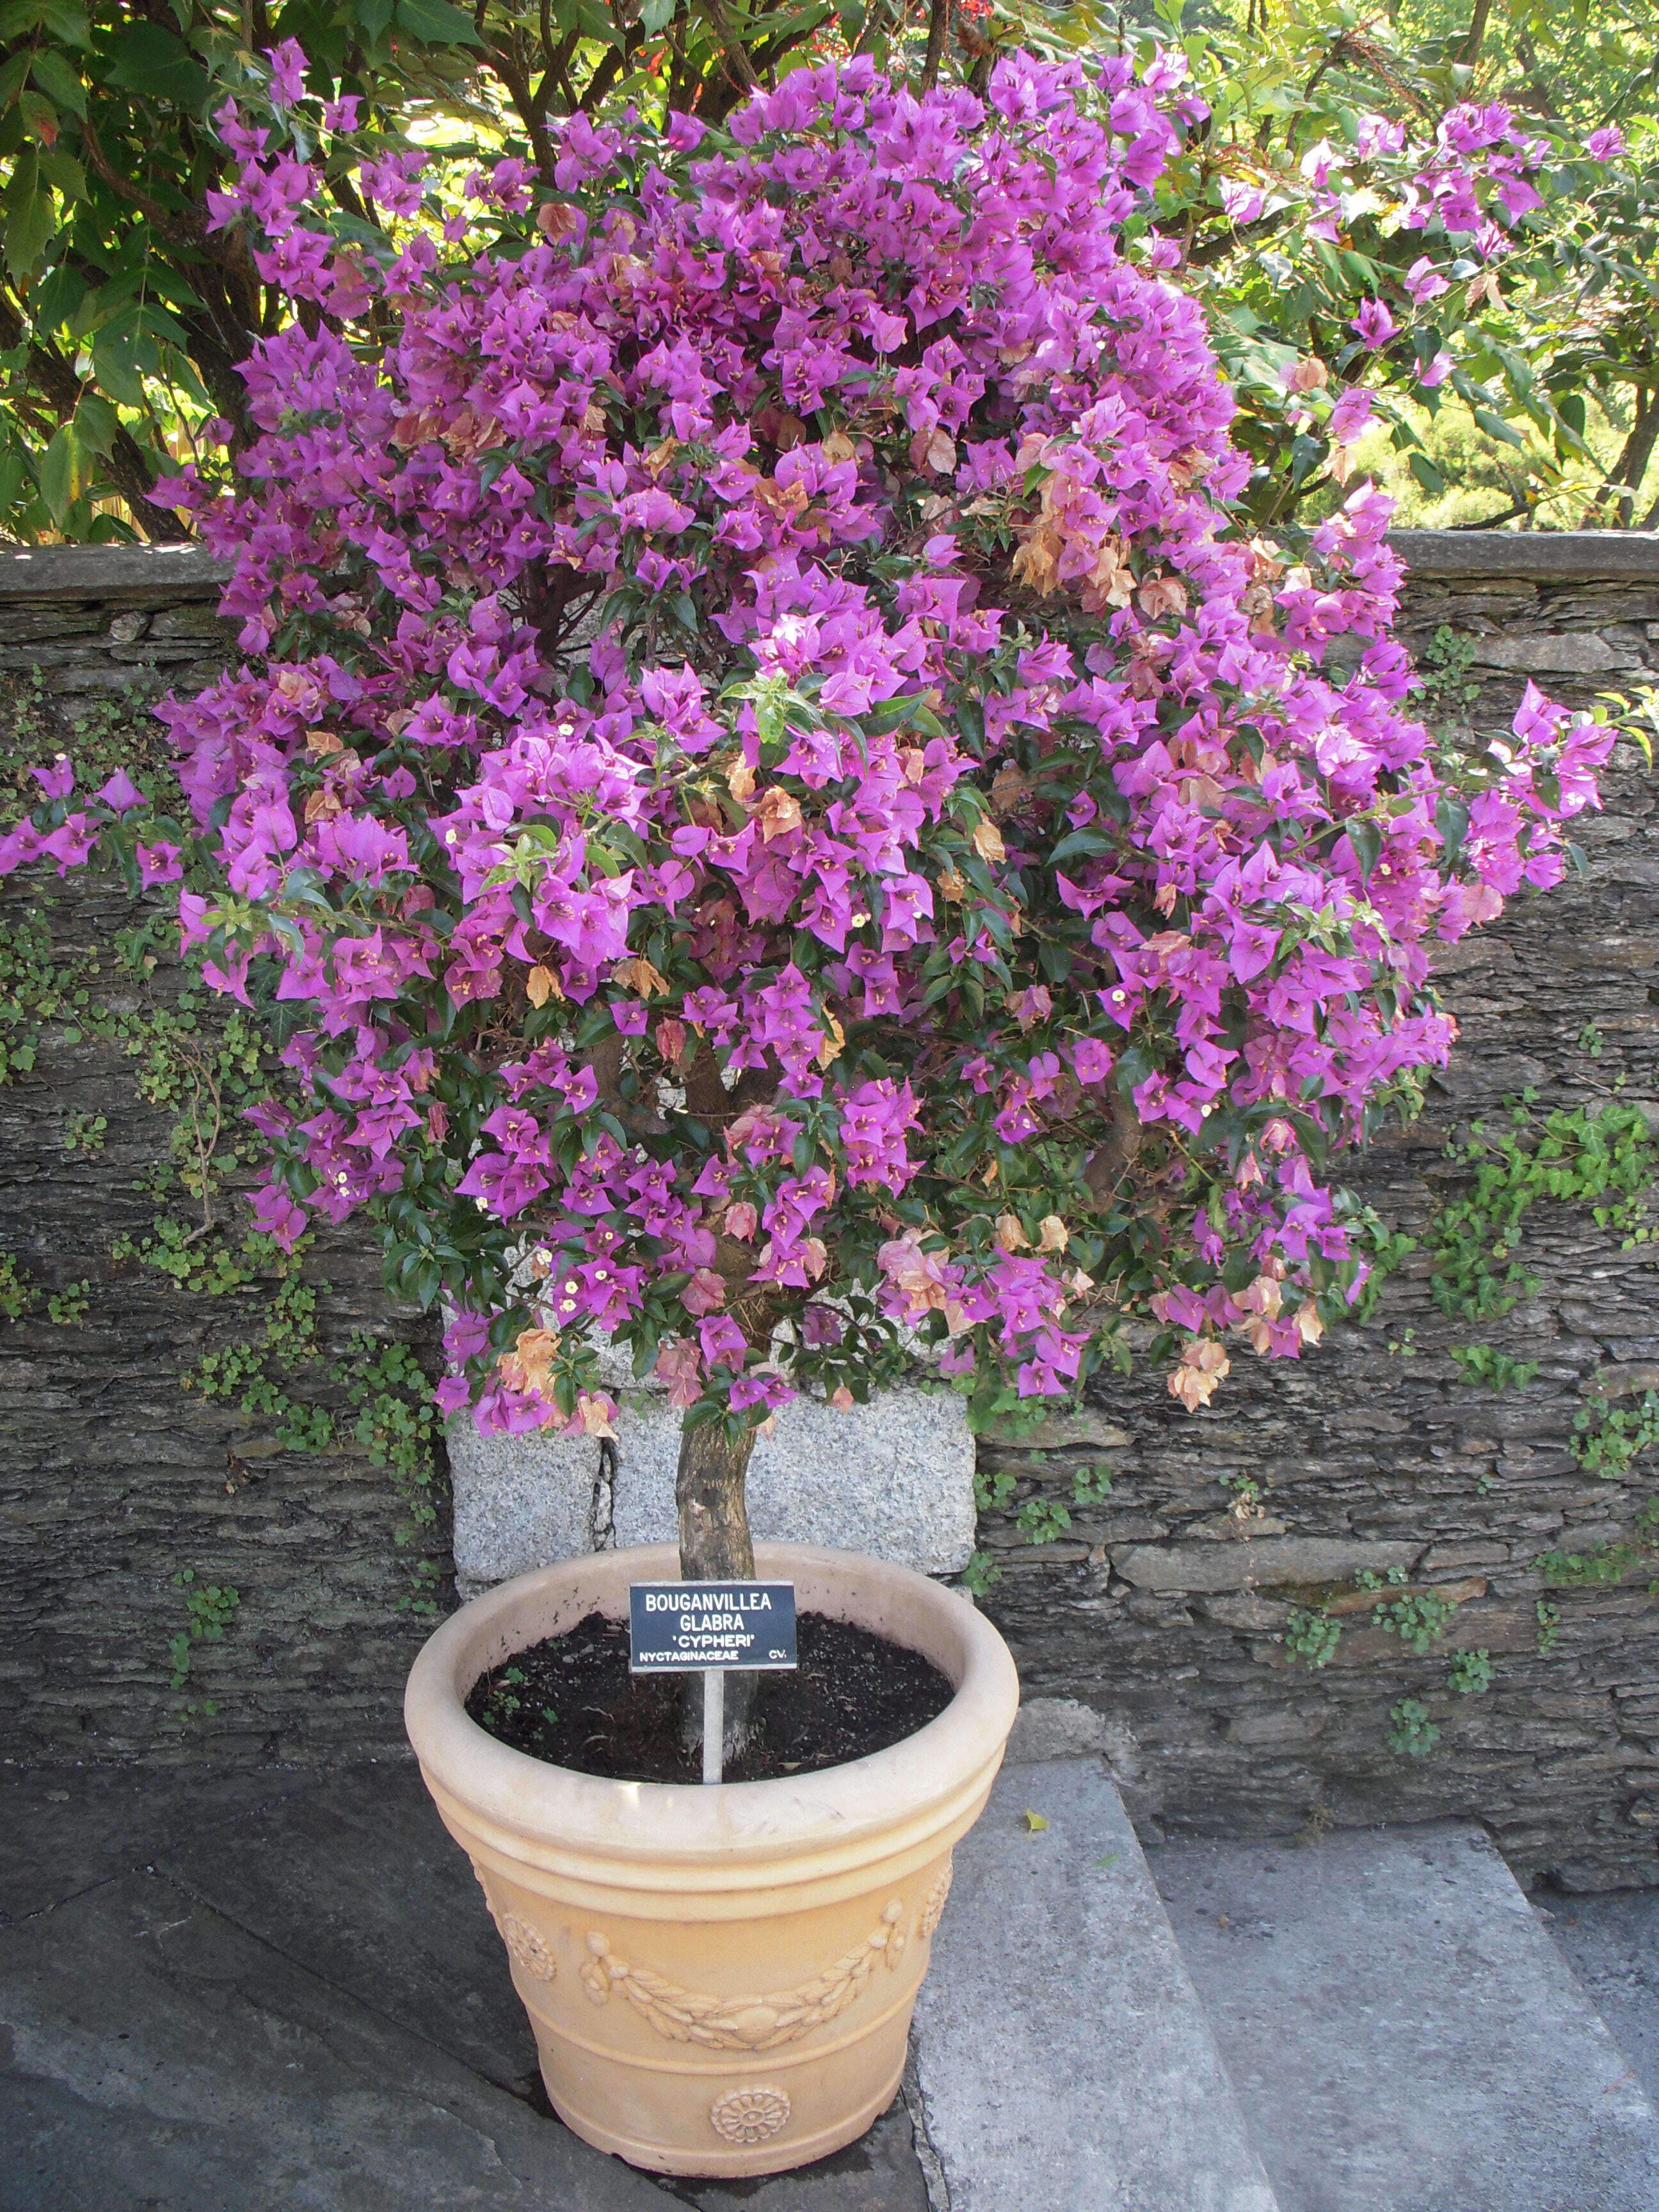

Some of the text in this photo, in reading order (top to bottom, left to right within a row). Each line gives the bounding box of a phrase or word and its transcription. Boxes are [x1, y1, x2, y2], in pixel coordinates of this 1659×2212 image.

[646, 1593, 772, 1612] BOUGANVILLEA
[680, 1614, 744, 1631] GLABRA
[639, 1650, 739, 1662] NYCTAGINACEAE
